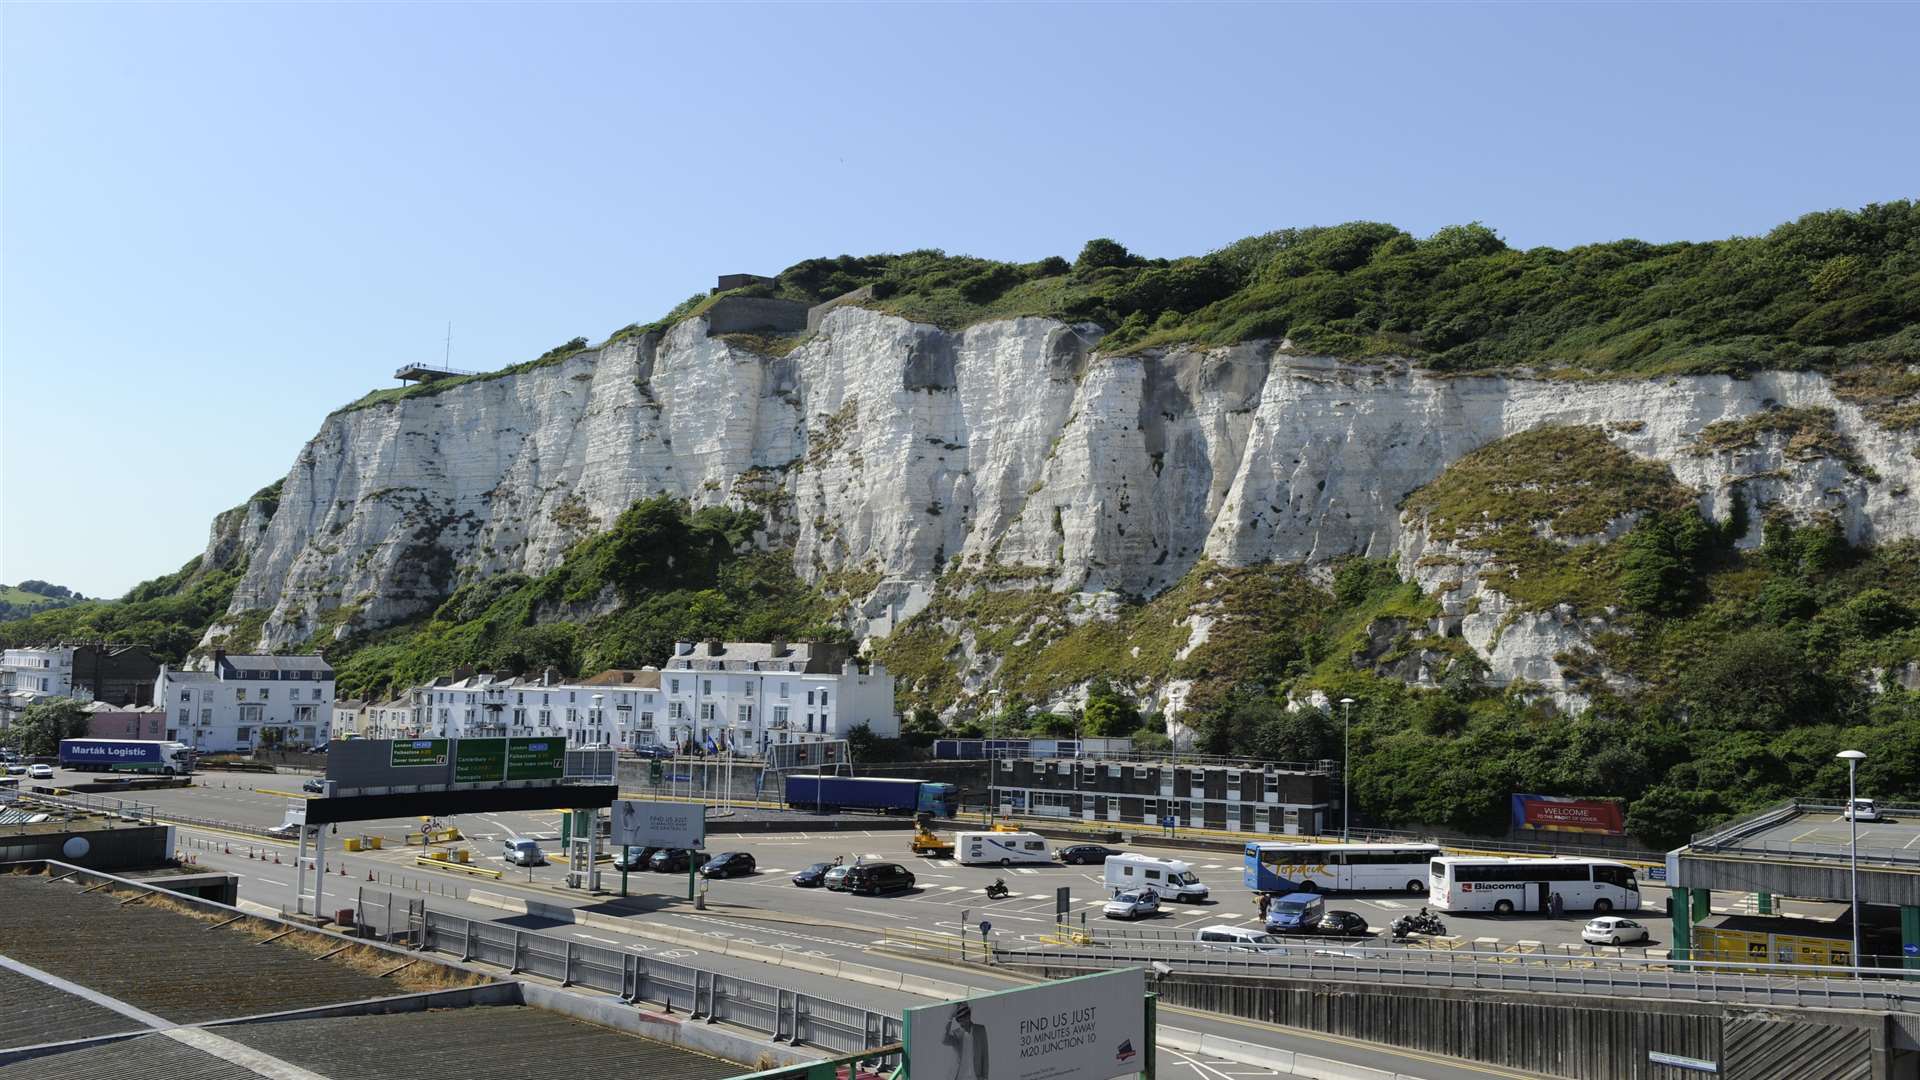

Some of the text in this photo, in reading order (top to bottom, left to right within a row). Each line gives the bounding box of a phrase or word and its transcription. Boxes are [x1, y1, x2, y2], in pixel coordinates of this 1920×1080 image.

[72, 745, 147, 757] Marták Logistic
[1544, 807, 1589, 817] WELCOME
[1020, 1006, 1097, 1034] FIND US JUST
[1020, 1022, 1096, 1046] 30 MINUTES AWAY
[1020, 1032, 1097, 1058] M20 JUNCTION 10
